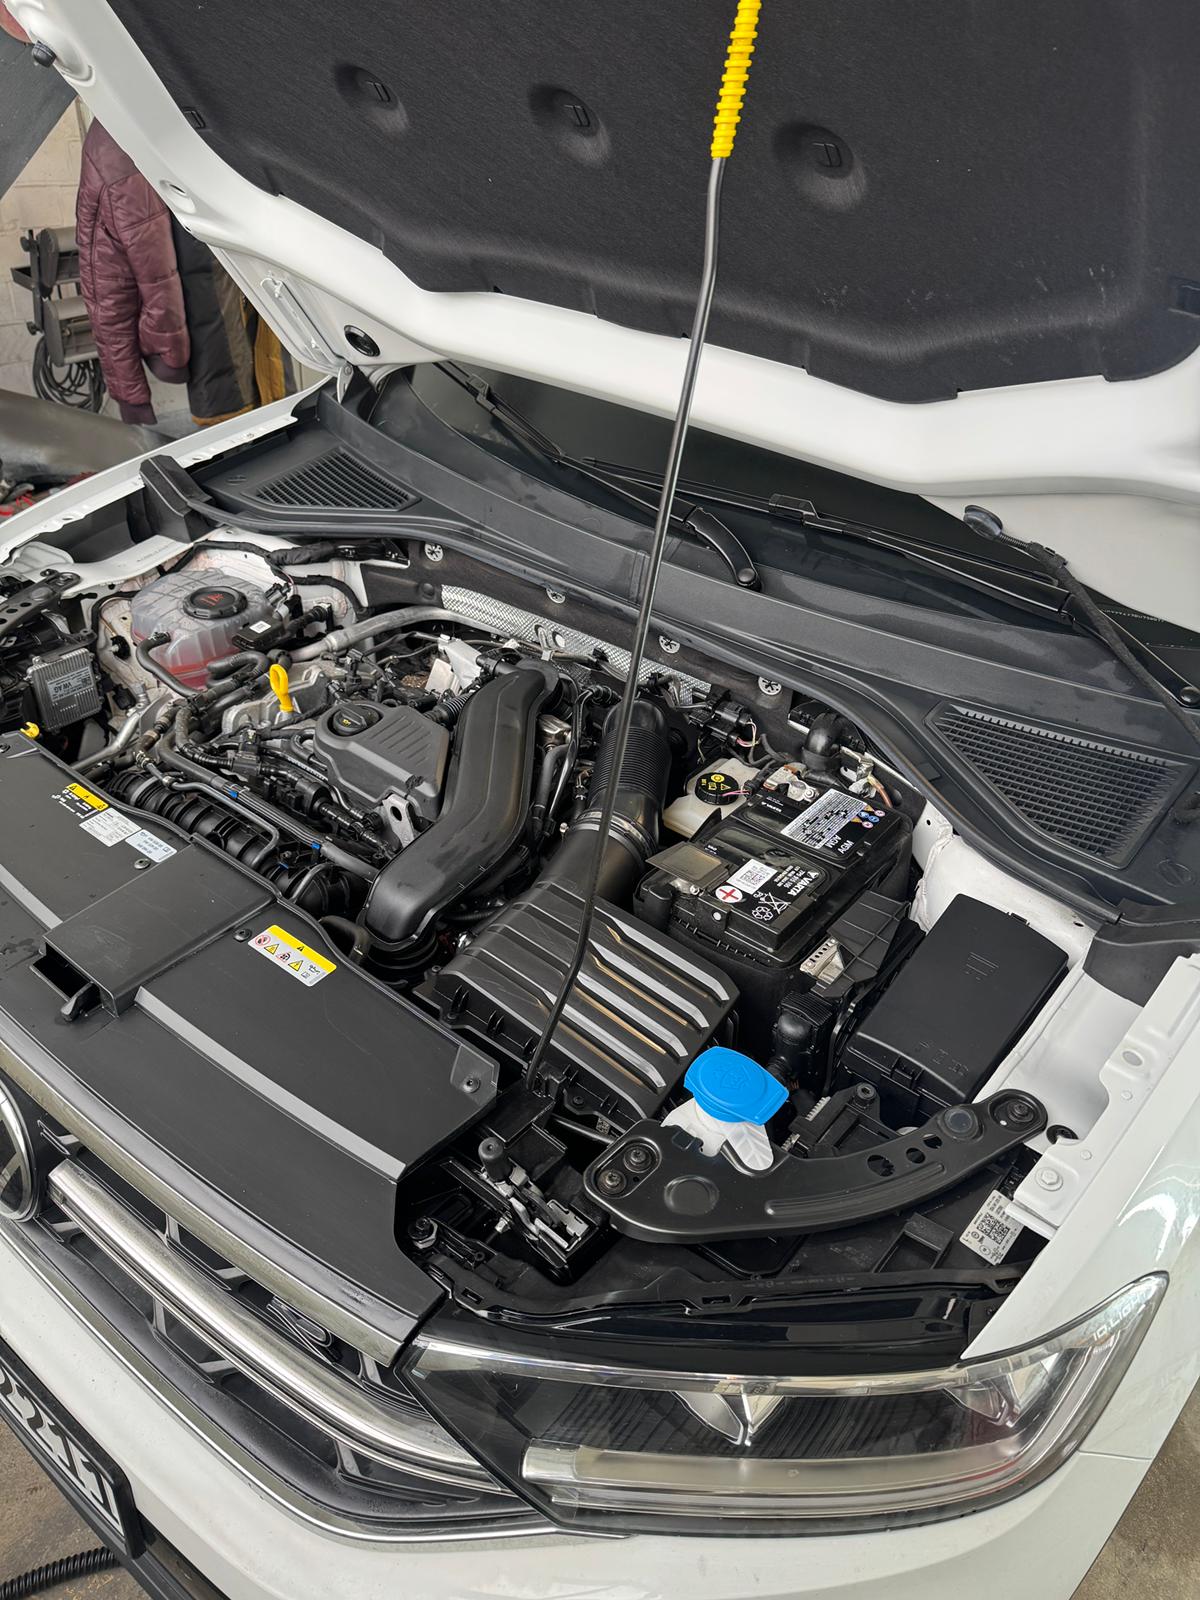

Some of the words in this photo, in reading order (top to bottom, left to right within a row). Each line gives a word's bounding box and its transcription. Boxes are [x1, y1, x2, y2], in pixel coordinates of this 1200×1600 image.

[825, 834, 842, 849] AGM
[837, 839, 855, 854] AGM
[787, 876, 813, 897] VARTA
